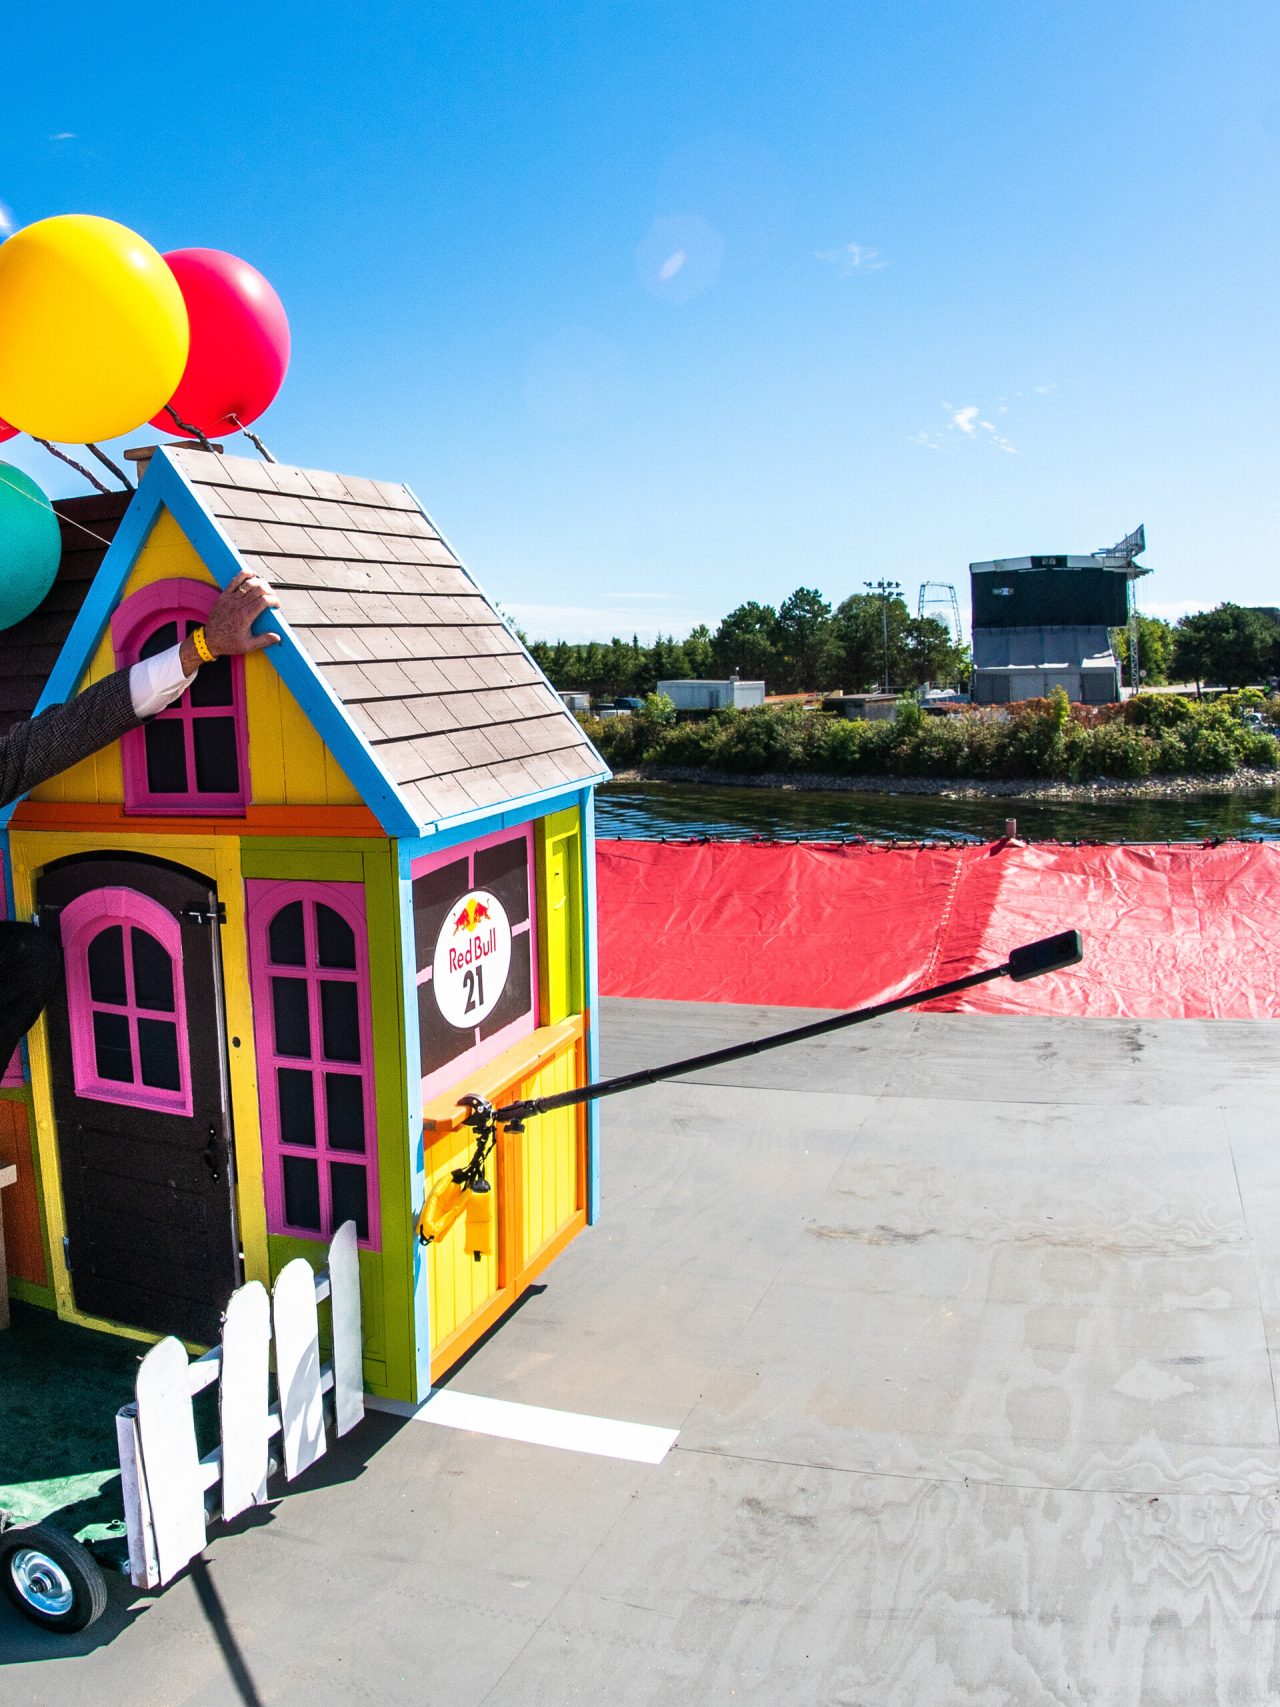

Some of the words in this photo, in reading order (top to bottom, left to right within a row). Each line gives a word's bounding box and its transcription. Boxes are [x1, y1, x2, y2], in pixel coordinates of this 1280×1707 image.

[449, 938, 473, 974] Red
[473, 927, 497, 961] Bull
[462, 964, 485, 1015] 21
